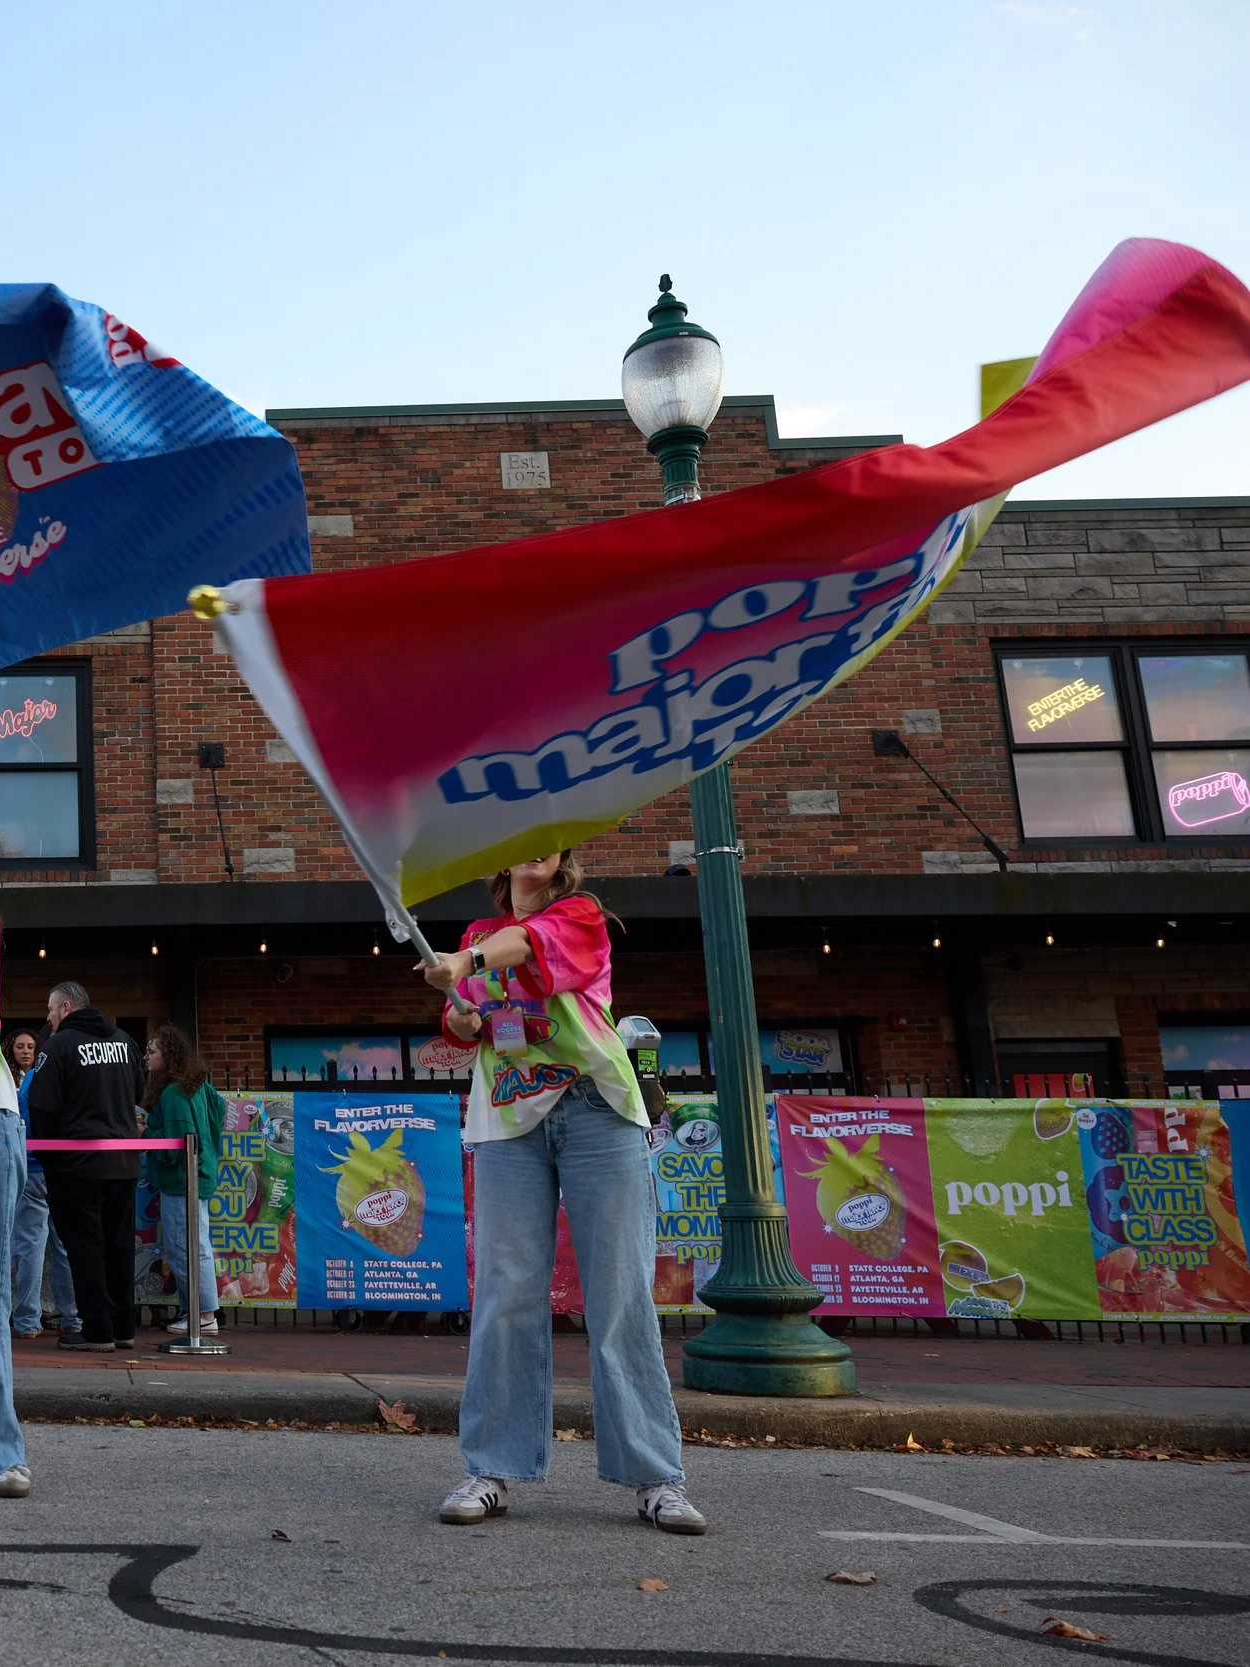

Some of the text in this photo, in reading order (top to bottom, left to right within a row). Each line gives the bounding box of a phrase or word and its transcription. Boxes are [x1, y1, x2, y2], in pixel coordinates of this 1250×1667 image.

[21, 436, 86, 477] TO
[508, 455, 540, 469] Est.
[506, 471, 546, 486] 1975
[1027, 677, 1091, 718] ENTER THE
[1026, 684, 1106, 733] FLAVORVERSE
[1172, 773, 1233, 807] poppi
[77, 1041, 129, 1067] SECURITY
[335, 1104, 415, 1119] ENTER THE
[809, 1110, 891, 1124] ENTER THE
[314, 1117, 437, 1134] FLAVORVERSE
[789, 1122, 914, 1139] FLAVORVERSE
[216, 1165, 249, 1188] AY
[661, 1155, 725, 1179] SAVO
[1120, 1157, 1203, 1181] TASTE
[267, 1176, 287, 1208] poppi
[367, 1190, 392, 1208] poppi
[680, 1186, 727, 1207] THE
[944, 1170, 1073, 1217] poppi
[1132, 1188, 1202, 1211] WITH
[208, 1194, 243, 1218] OU
[848, 1196, 873, 1213] poppi
[656, 1215, 723, 1238] MOME
[1128, 1219, 1214, 1242] CLASS
[209, 1225, 279, 1250] ERVE
[214, 1251, 254, 1278] ppi
[326, 1260, 347, 1268] OCTOBER
[363, 1260, 389, 1268] STATE
[390, 1260, 430, 1269] COLLEGE,
[431, 1261, 443, 1269] PA
[677, 1244, 722, 1265] pop
[1138, 1243, 1211, 1271] poppi
[326, 1270, 419, 1279] OCTOBER 17 ATLANTA, GA
[834, 1274, 840, 1283] 17
[850, 1275, 890, 1283] ATLANTA,
[891, 1275, 905, 1283] GA
[848, 1264, 873, 1273] STATE
[875, 1265, 916, 1274] COLLEGE,
[917, 1265, 929, 1274] PA
[326, 1280, 348, 1288] OCTOBER
[364, 1281, 423, 1290] FAYETTEVILLE,
[424, 1282, 437, 1290] AR
[365, 1291, 430, 1300] BLOOMINGTON,
[431, 1292, 442, 1300] IN
[851, 1285, 910, 1294] FAYETTEVILLE,
[912, 1286, 924, 1294] AR
[852, 1296, 918, 1305] BLOOMINGTON,
[919, 1297, 929, 1305] IN
